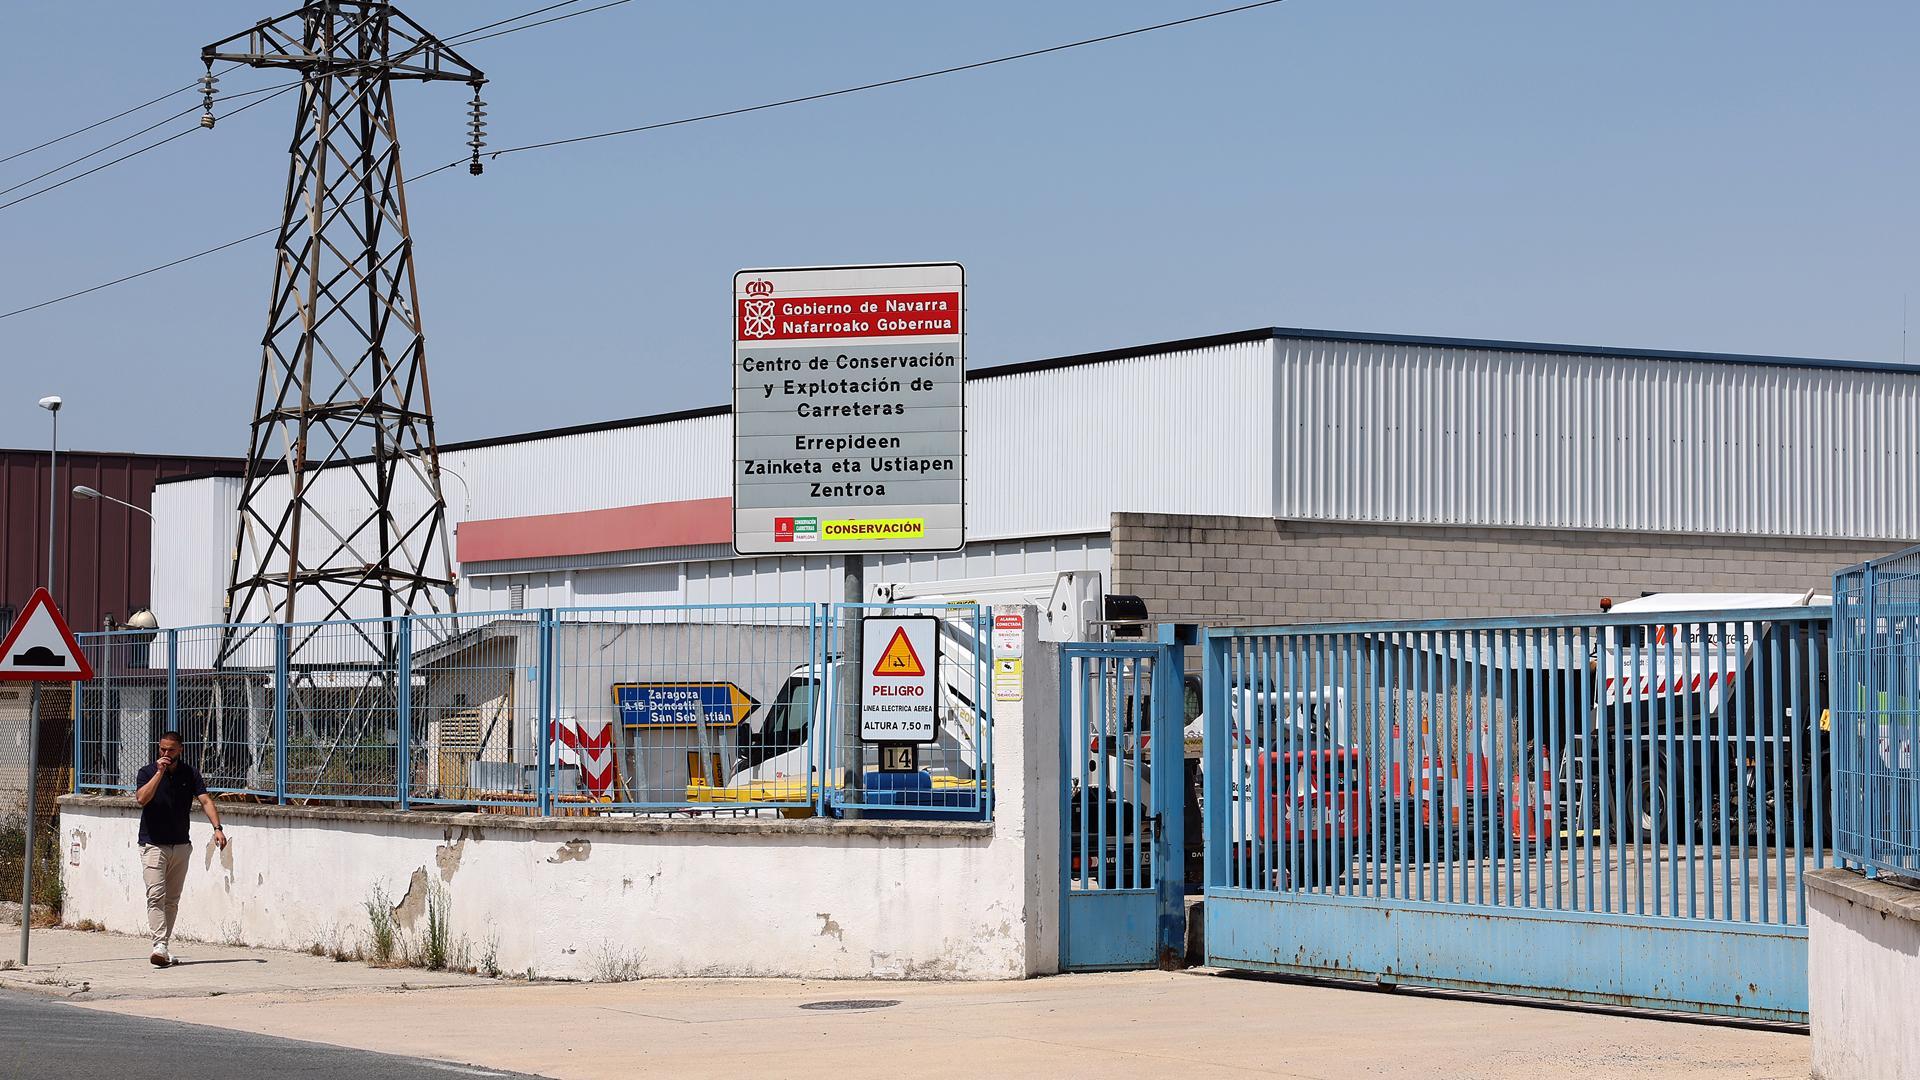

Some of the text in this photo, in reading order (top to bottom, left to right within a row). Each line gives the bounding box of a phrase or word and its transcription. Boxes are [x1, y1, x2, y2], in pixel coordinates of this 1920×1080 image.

[782, 300, 947, 315] Gobierno de Navarra
[782, 318, 952, 334] Nafarroako Gobernua
[743, 352, 955, 373] Centro de Conservación
[764, 377, 934, 398] y Explotación de
[797, 402, 905, 418] Carreteras
[795, 435, 901, 452] Errepideen
[744, 456, 954, 475] Zainketa eta Ustiapen
[810, 482, 886, 498] Zentroa
[825, 521, 922, 535] CONSERVACIÓN
[648, 689, 699, 701] Zaragoza
[872, 685, 925, 697] PELIGRO
[624, 701, 645, 711] A-15
[913, 704, 933, 712] AEREA
[651, 711, 732, 723] San Sebstián
[864, 721, 899, 730] ALTURA
[886, 749, 913, 768] 14
